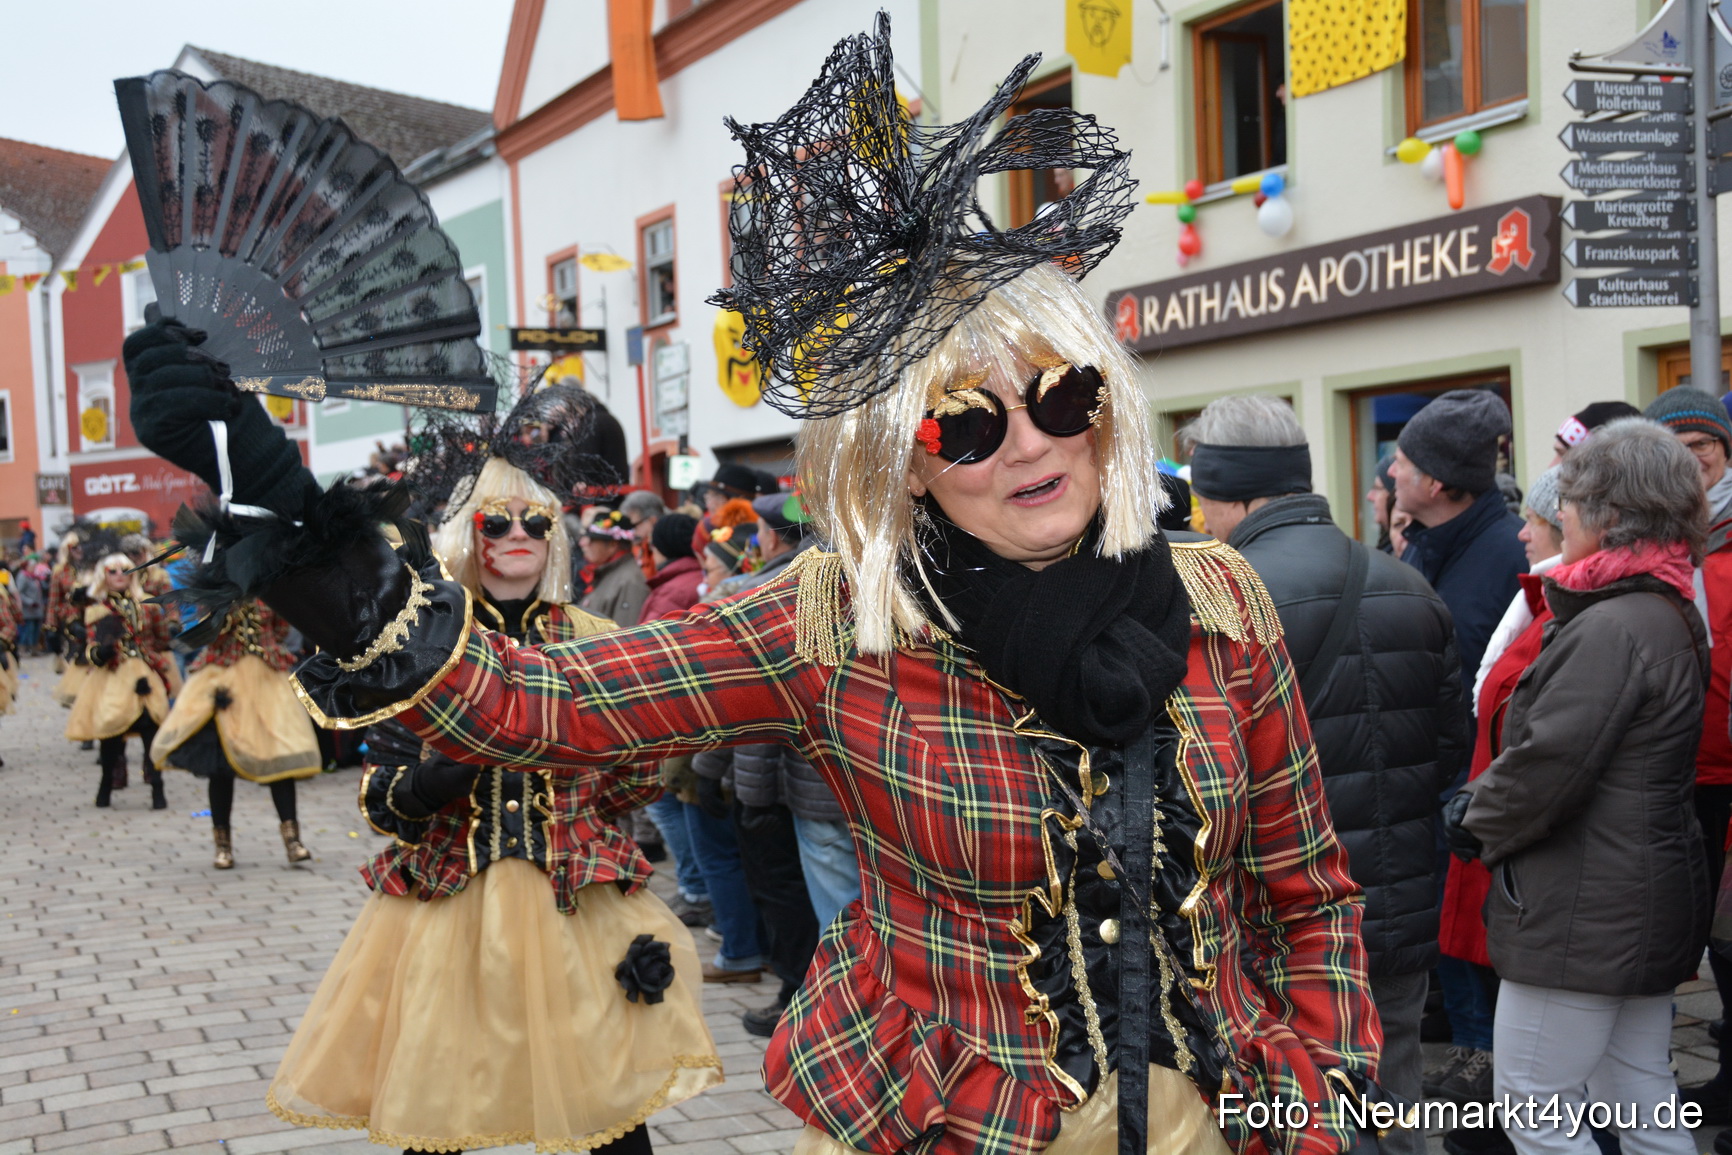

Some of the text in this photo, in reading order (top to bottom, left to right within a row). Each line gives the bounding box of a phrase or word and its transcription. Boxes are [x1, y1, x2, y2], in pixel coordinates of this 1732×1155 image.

[1594, 82, 1663, 95] Museum im
[1597, 96, 1661, 110] Hollerhaus
[1576, 128, 1679, 147] Wassertretanlage
[1579, 161, 1677, 174] Meditationshaus
[1573, 175, 1681, 188] Franziskanerkloster
[1594, 201, 1674, 216] Mariengrotte
[1608, 214, 1669, 230] Kreuzberg
[1585, 245, 1680, 264] Franziskuspark
[1142, 226, 1481, 336] RATHAUS APOTHEKE
[1598, 278, 1669, 292] Kulturhaus
[1589, 292, 1679, 306] Stadtbücherei
